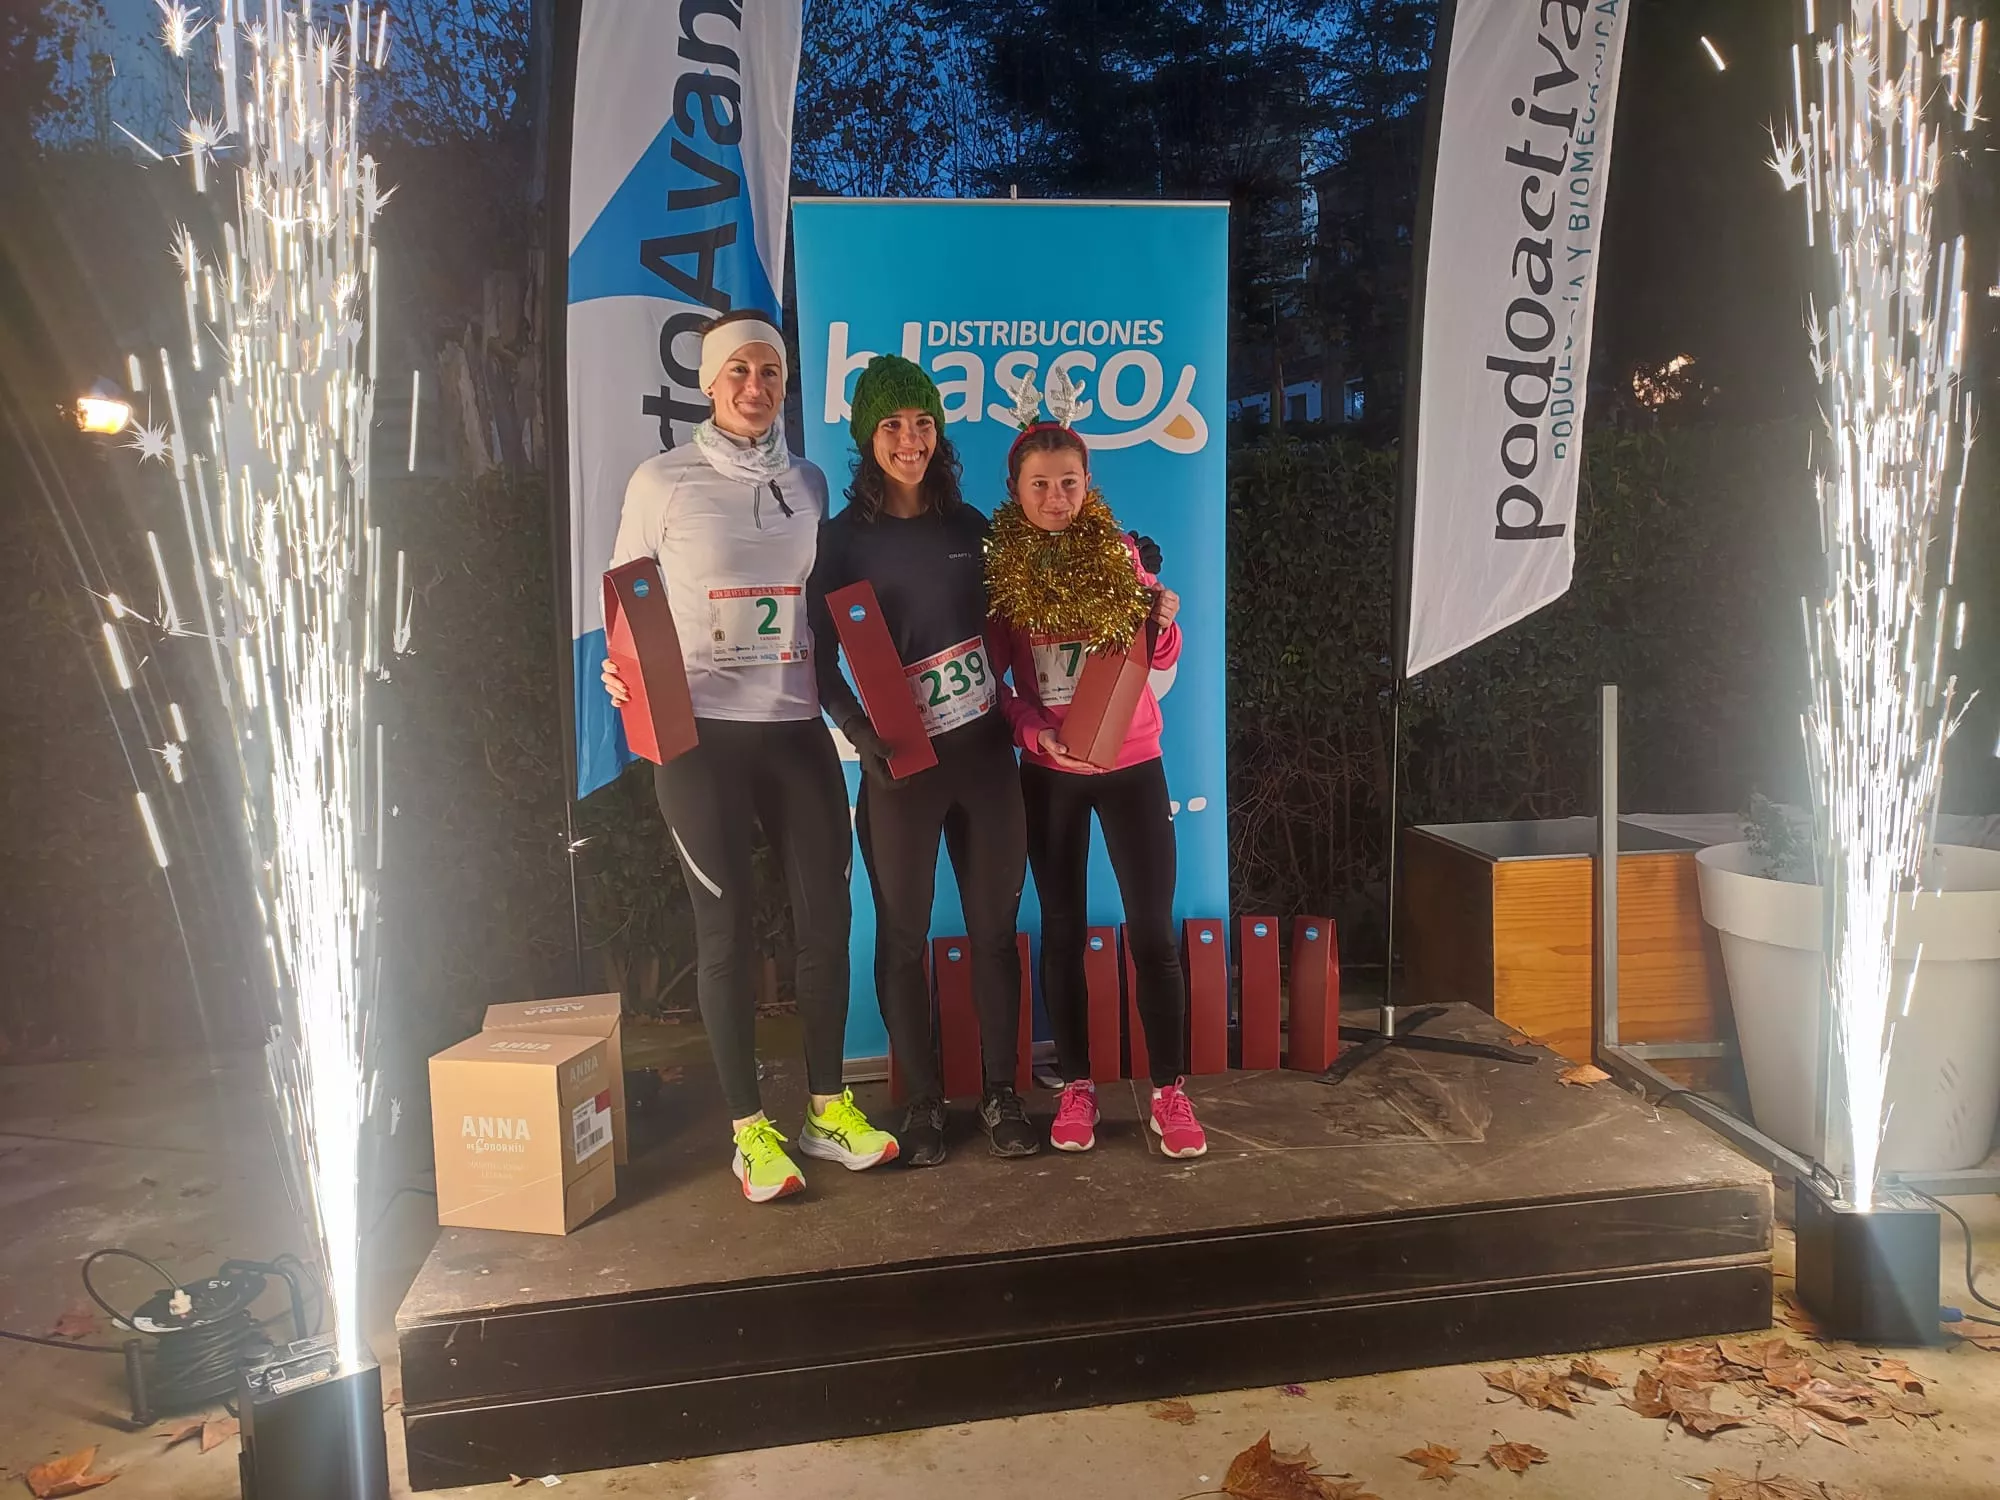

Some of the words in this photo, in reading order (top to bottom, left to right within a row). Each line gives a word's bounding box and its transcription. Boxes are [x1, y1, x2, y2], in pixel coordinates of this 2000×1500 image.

[1567, 245, 1592, 262] Y
[1486, 0, 1589, 541] podoactiva
[928, 319, 1165, 347] DISTRIBUCIONES
[755, 597, 781, 635] 2
[920, 651, 986, 707] 239
[489, 1041, 552, 1050] ANNA
[462, 1116, 531, 1140] ANNA
